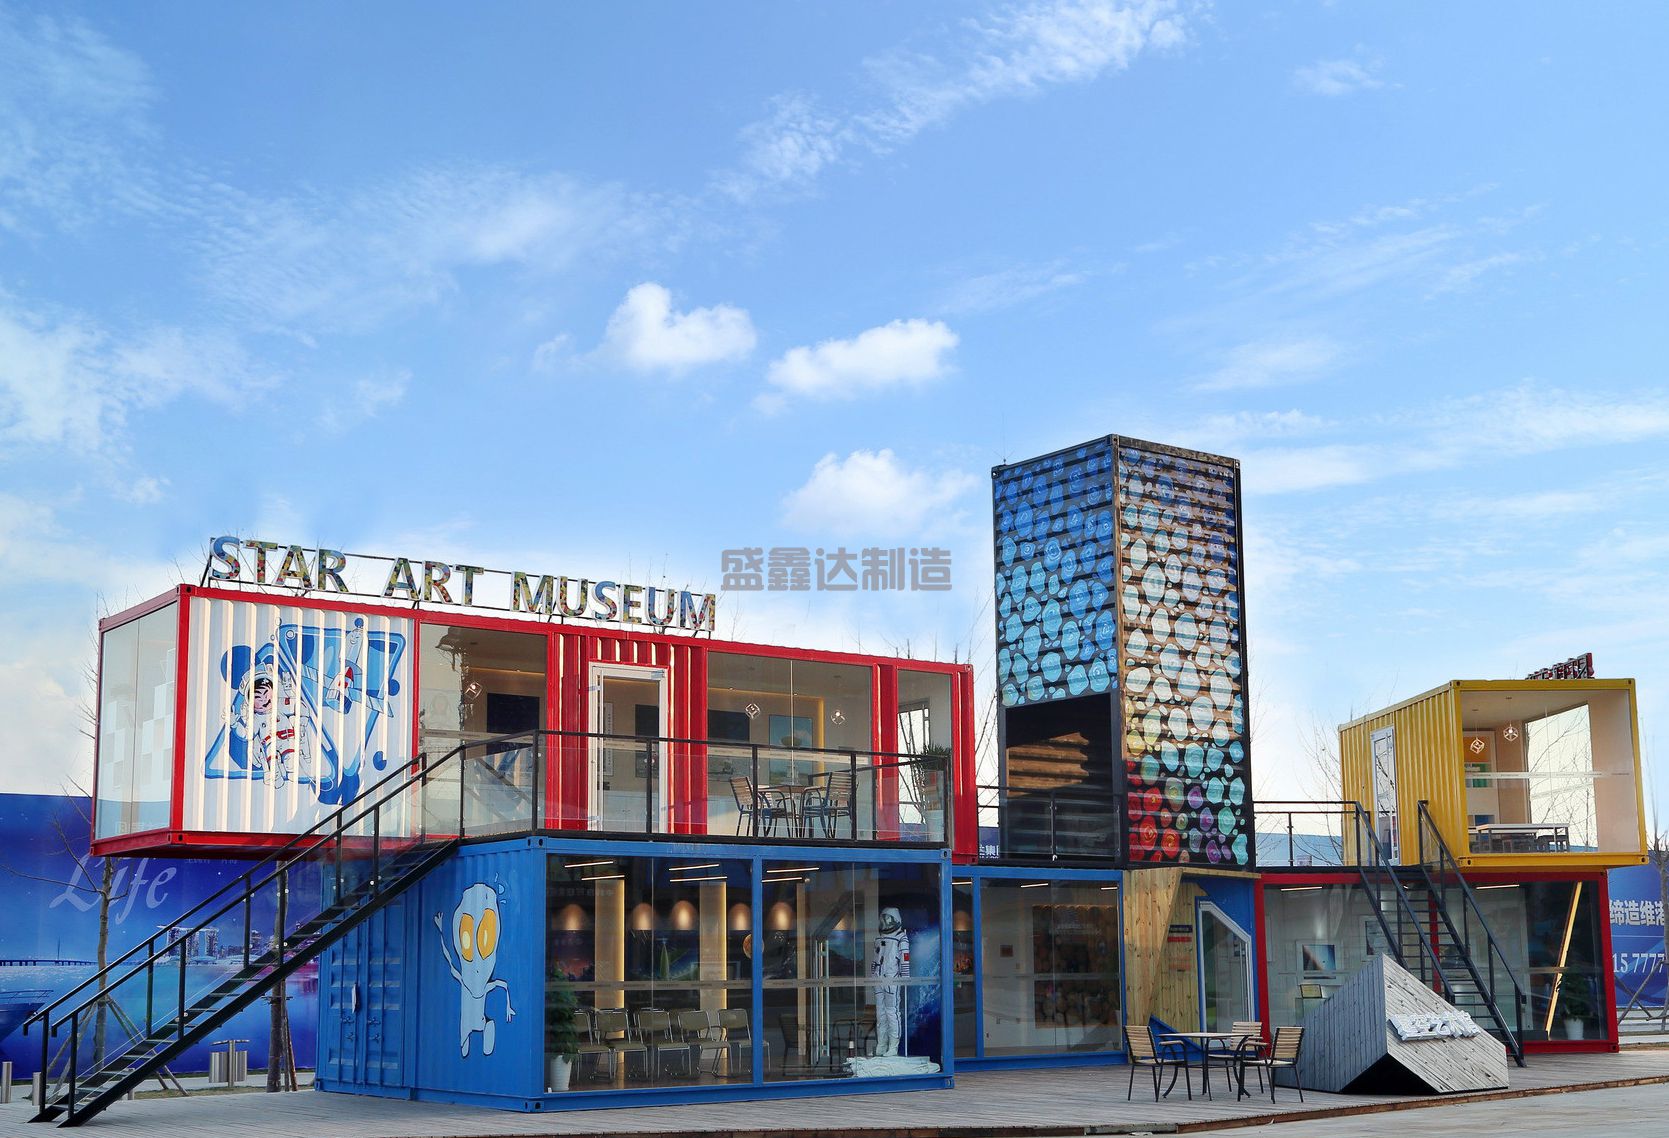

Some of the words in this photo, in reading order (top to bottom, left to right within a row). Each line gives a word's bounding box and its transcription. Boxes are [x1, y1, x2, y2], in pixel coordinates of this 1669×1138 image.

[211, 536, 348, 592] STAR
[384, 557, 483, 606] ART
[511, 570, 716, 631] MUSEUM
